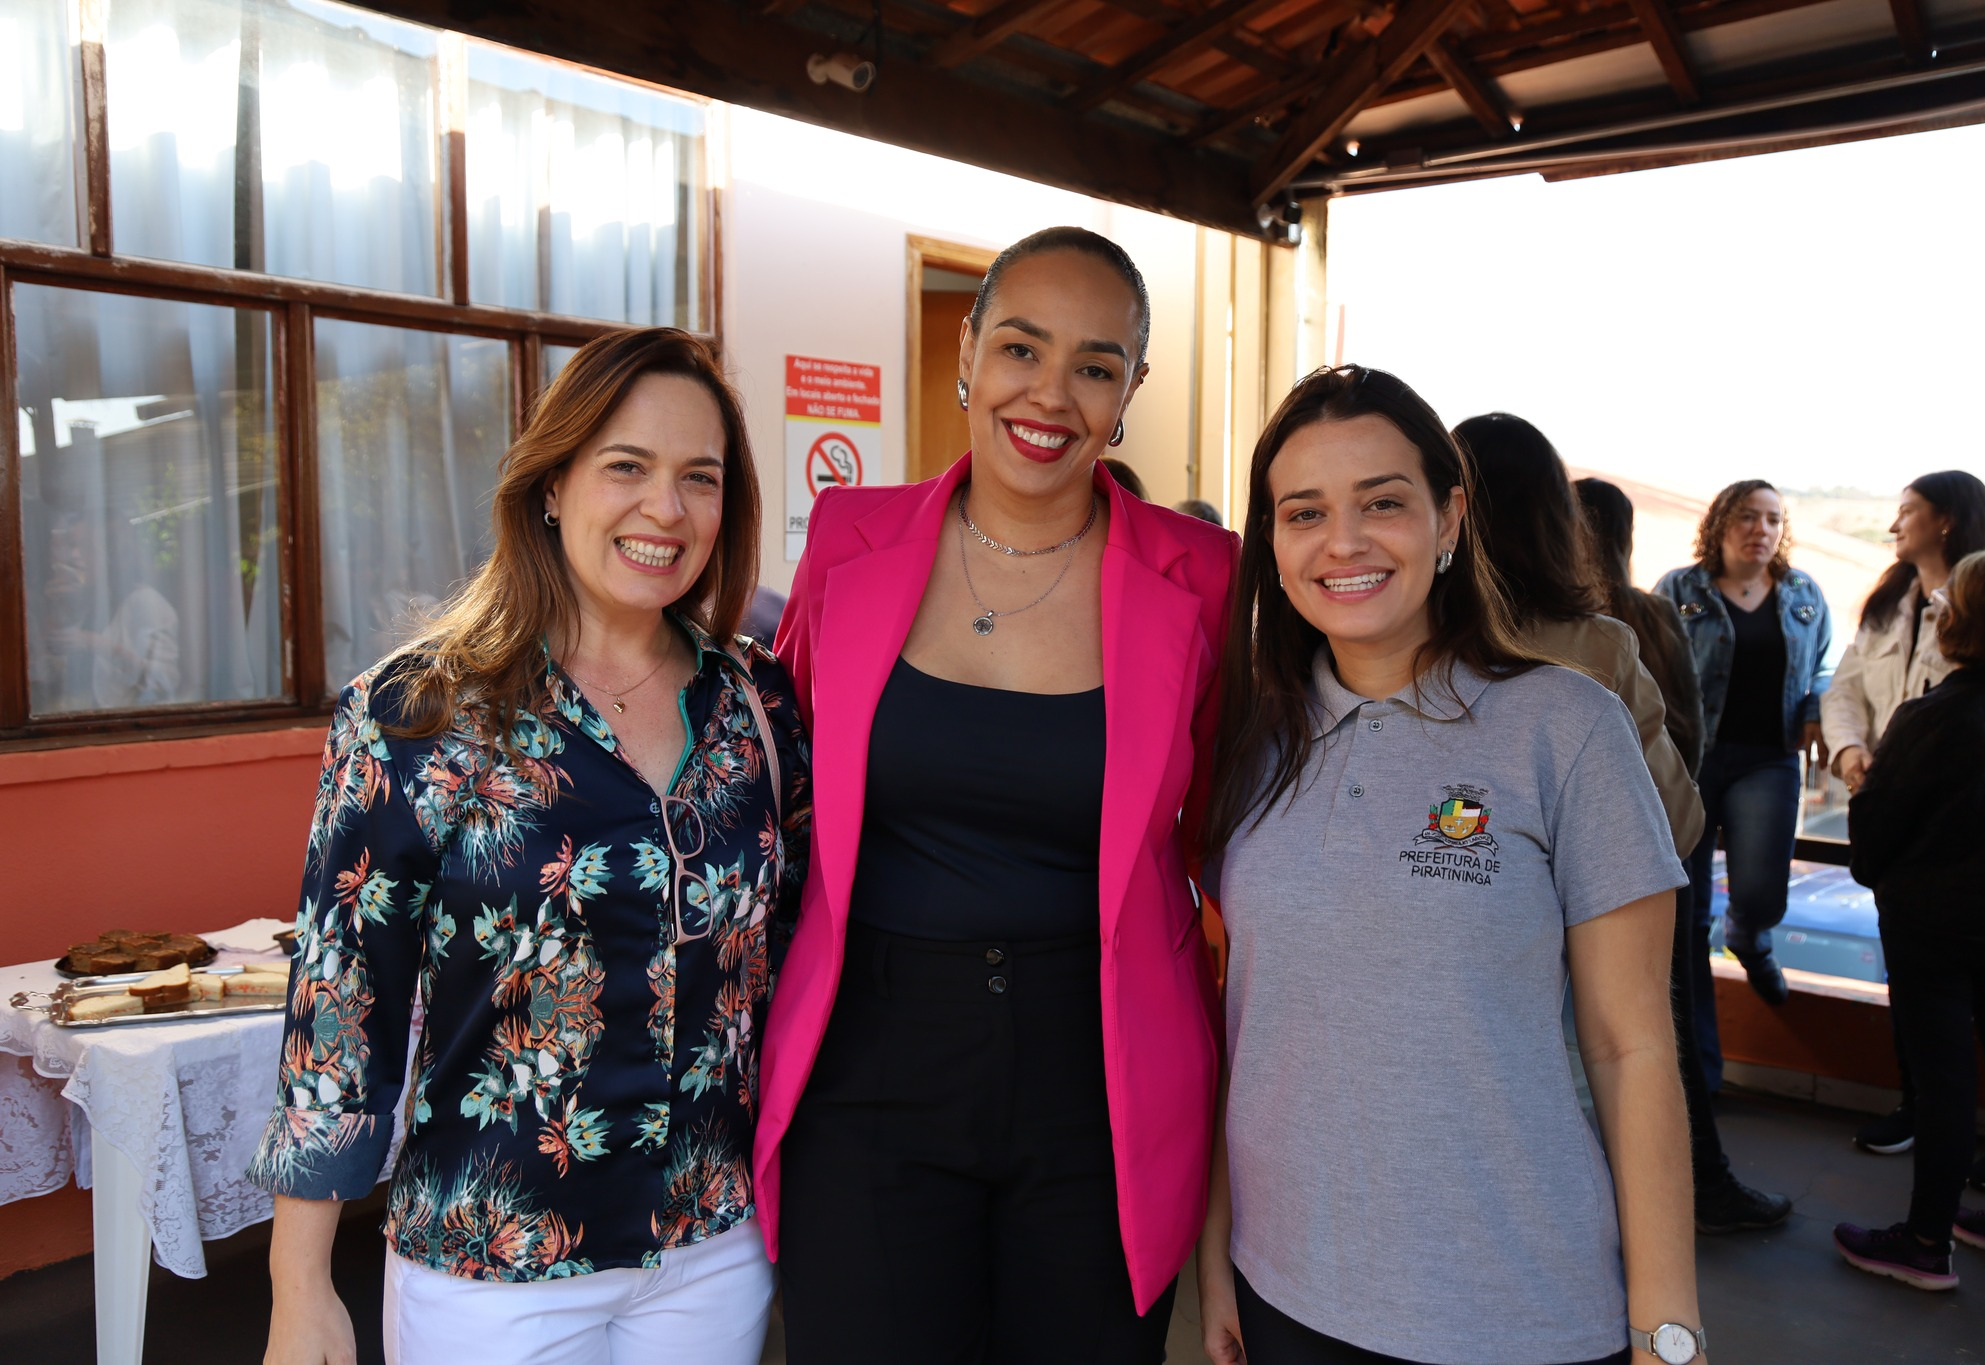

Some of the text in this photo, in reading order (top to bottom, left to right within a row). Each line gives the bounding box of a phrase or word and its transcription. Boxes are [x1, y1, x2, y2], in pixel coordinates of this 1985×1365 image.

[794, 358, 874, 377] Aqui se respeita a vida
[800, 375, 806, 384] e
[807, 376, 812, 385] o
[814, 375, 832, 386] meio
[786, 386, 798, 397] Em
[799, 388, 821, 400] locais
[823, 390, 845, 402] aberto
[852, 393, 880, 406] fechado
[807, 402, 825, 416] NÃO
[826, 405, 836, 416] SE
[1399, 850, 1500, 873] PREFEITURA DE
[1411, 865, 1491, 886] PIRATININGA
